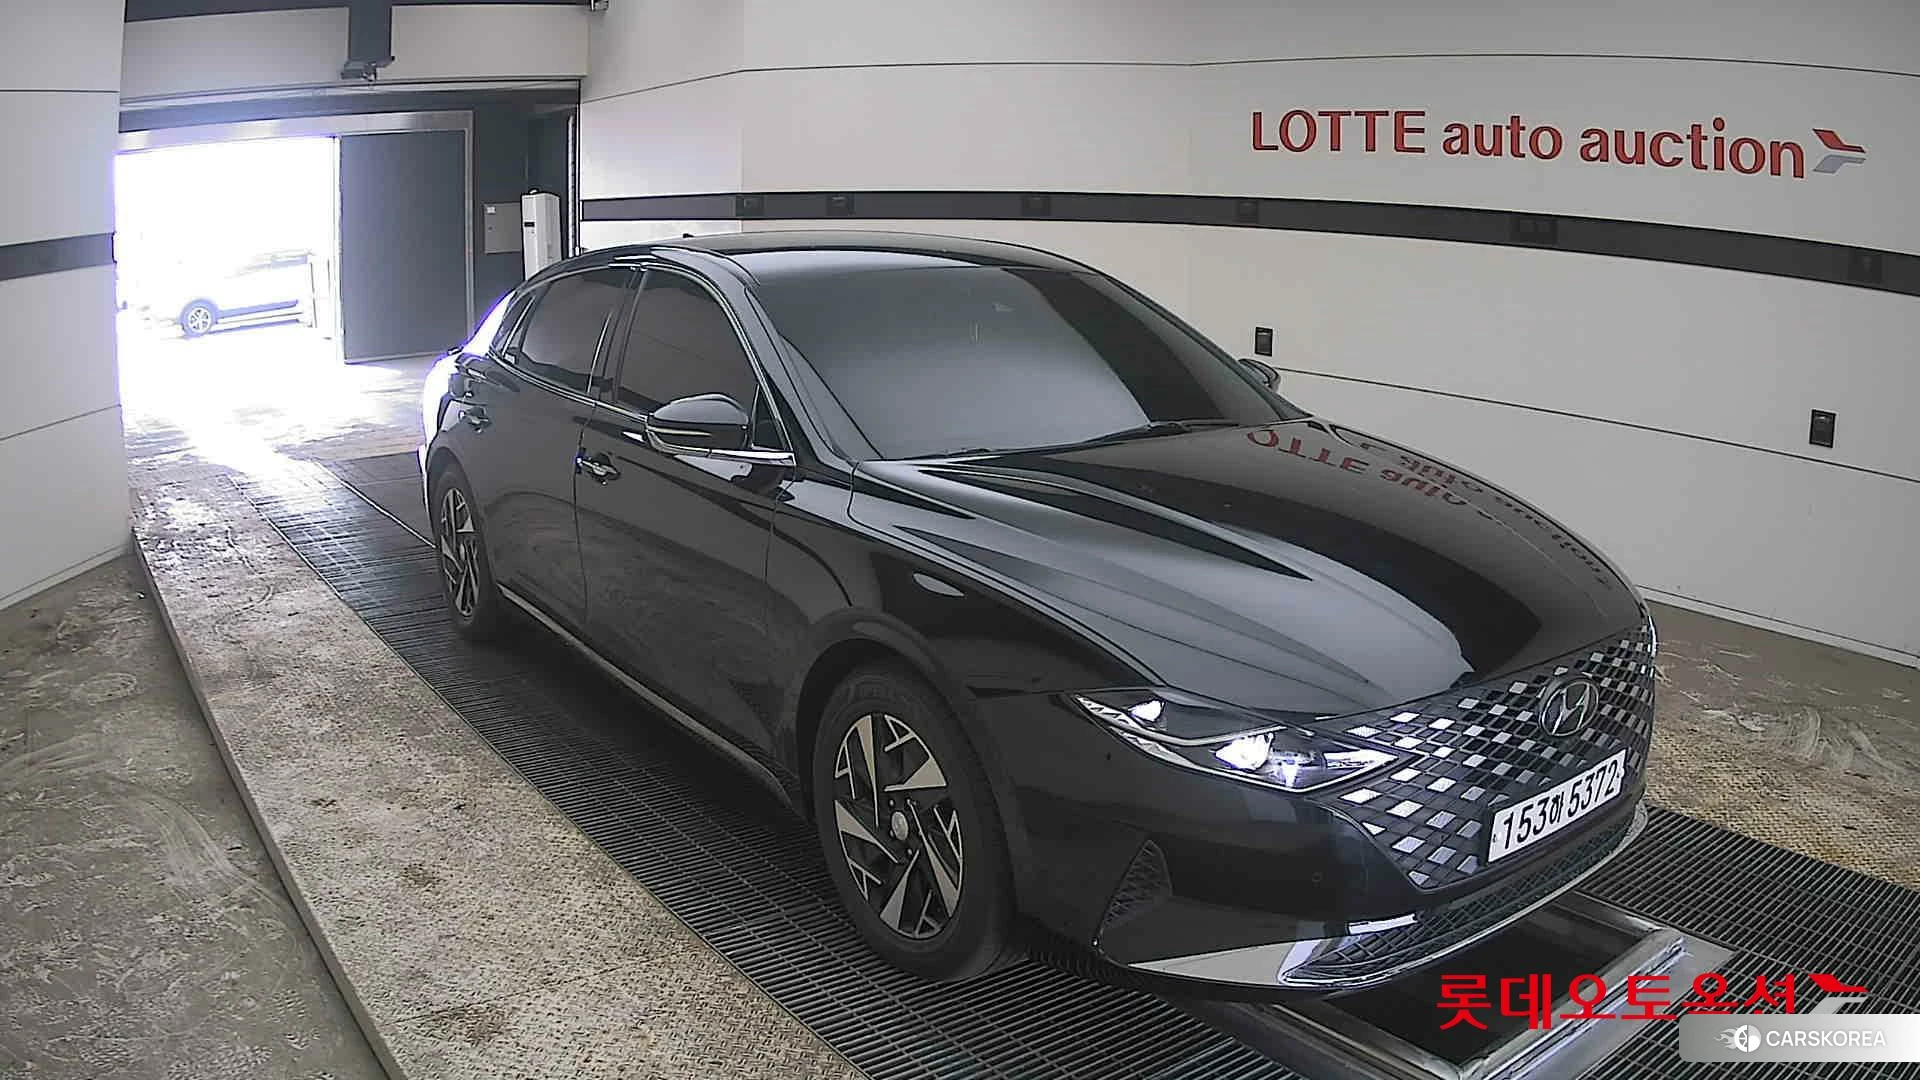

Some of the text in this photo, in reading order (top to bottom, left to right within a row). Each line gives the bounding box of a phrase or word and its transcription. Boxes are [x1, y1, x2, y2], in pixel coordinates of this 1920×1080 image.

[1252, 110, 1806, 179] LOTTE auto auction
[1567, 759, 1618, 818] 5372
